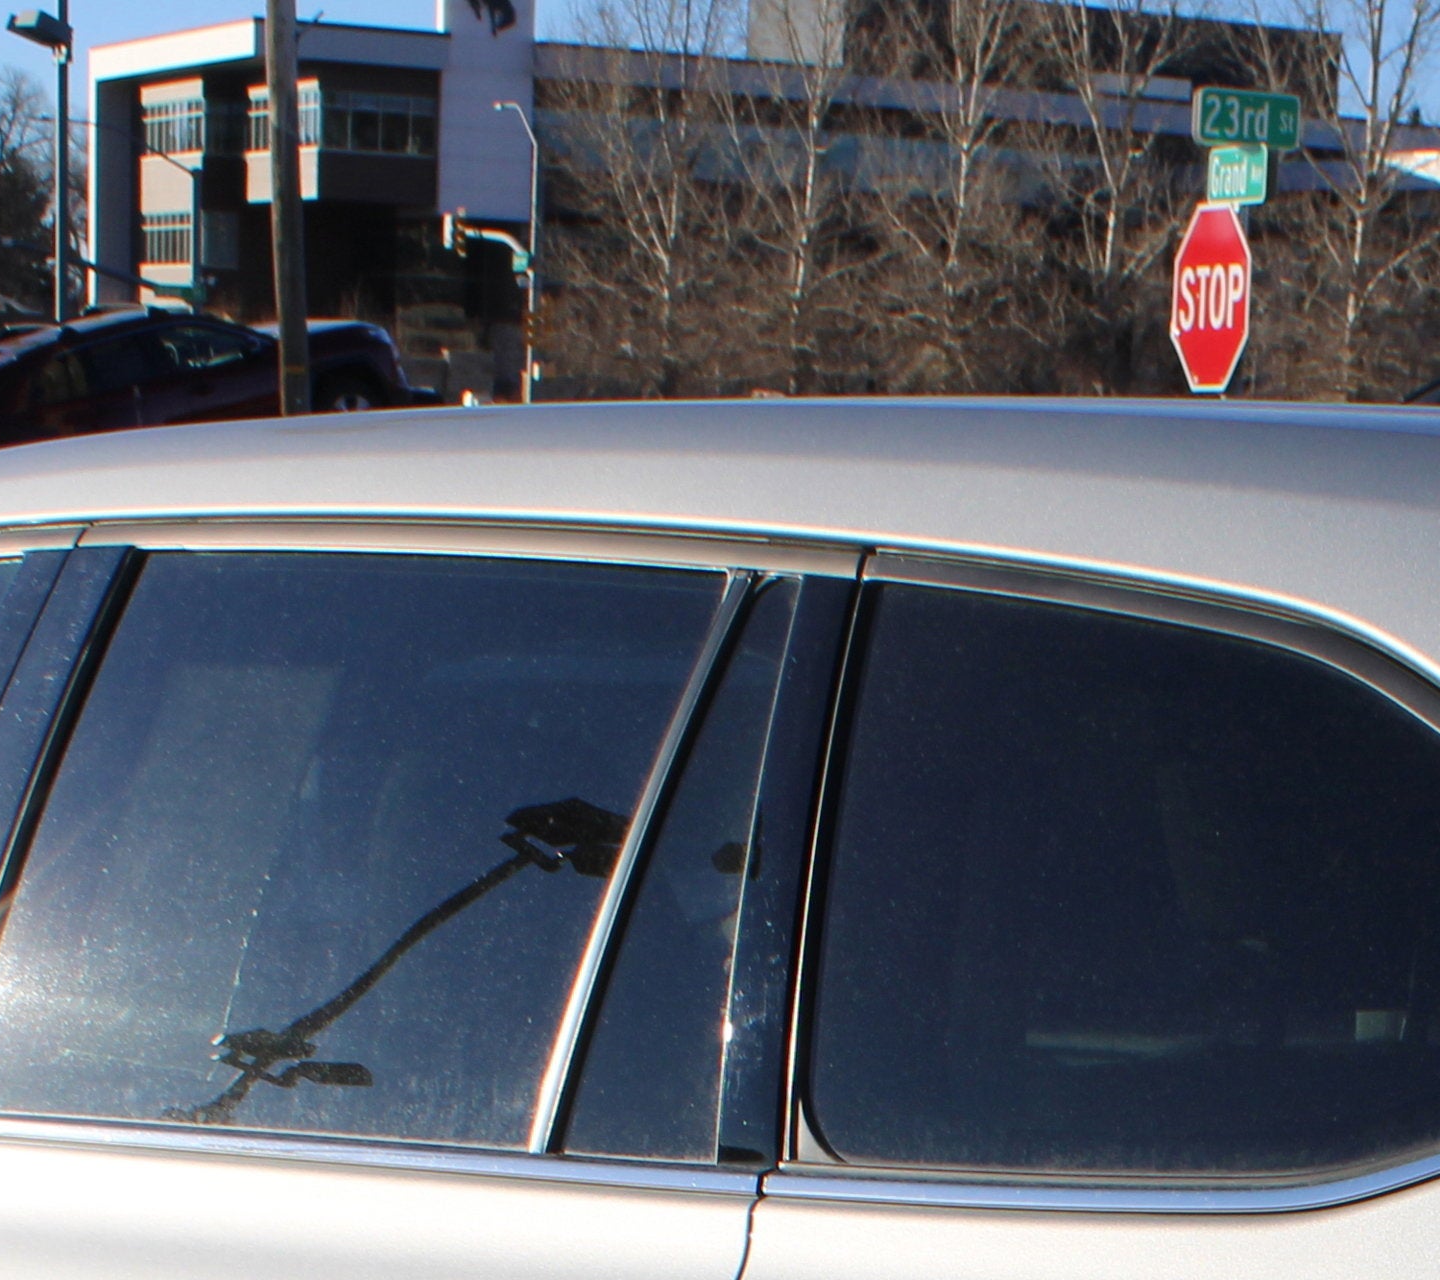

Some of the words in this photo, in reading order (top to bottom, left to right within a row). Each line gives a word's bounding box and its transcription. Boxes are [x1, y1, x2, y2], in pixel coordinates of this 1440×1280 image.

[1203, 94, 1270, 141] 23rd
[1279, 110, 1294, 134] St
[1211, 153, 1248, 198] Grand
[1178, 263, 1245, 332] STOP
